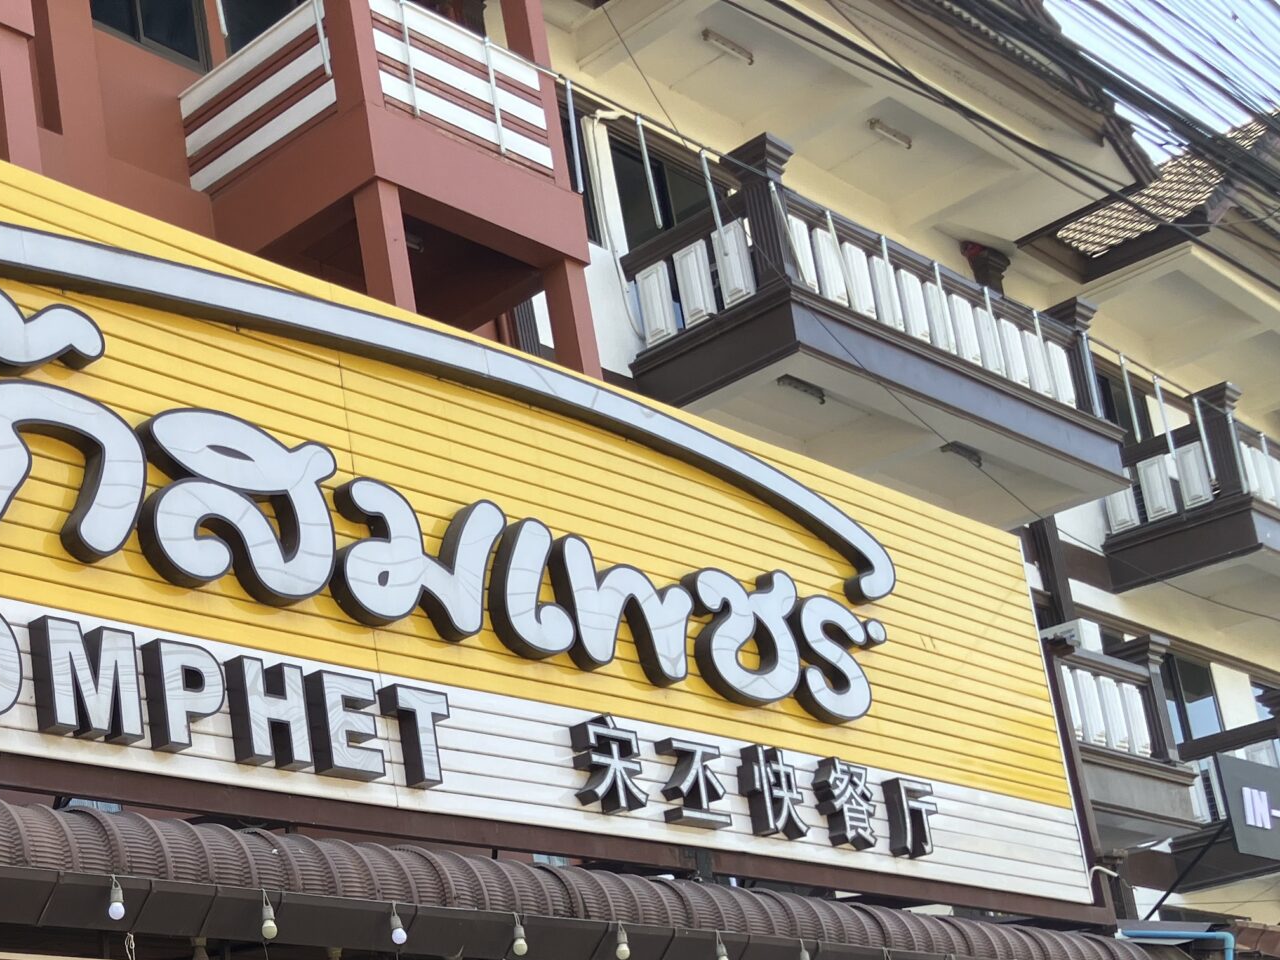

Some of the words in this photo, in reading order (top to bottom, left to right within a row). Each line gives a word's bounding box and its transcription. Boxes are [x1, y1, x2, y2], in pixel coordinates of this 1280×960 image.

[569, 713, 938, 861] 宋丕快餐厅
